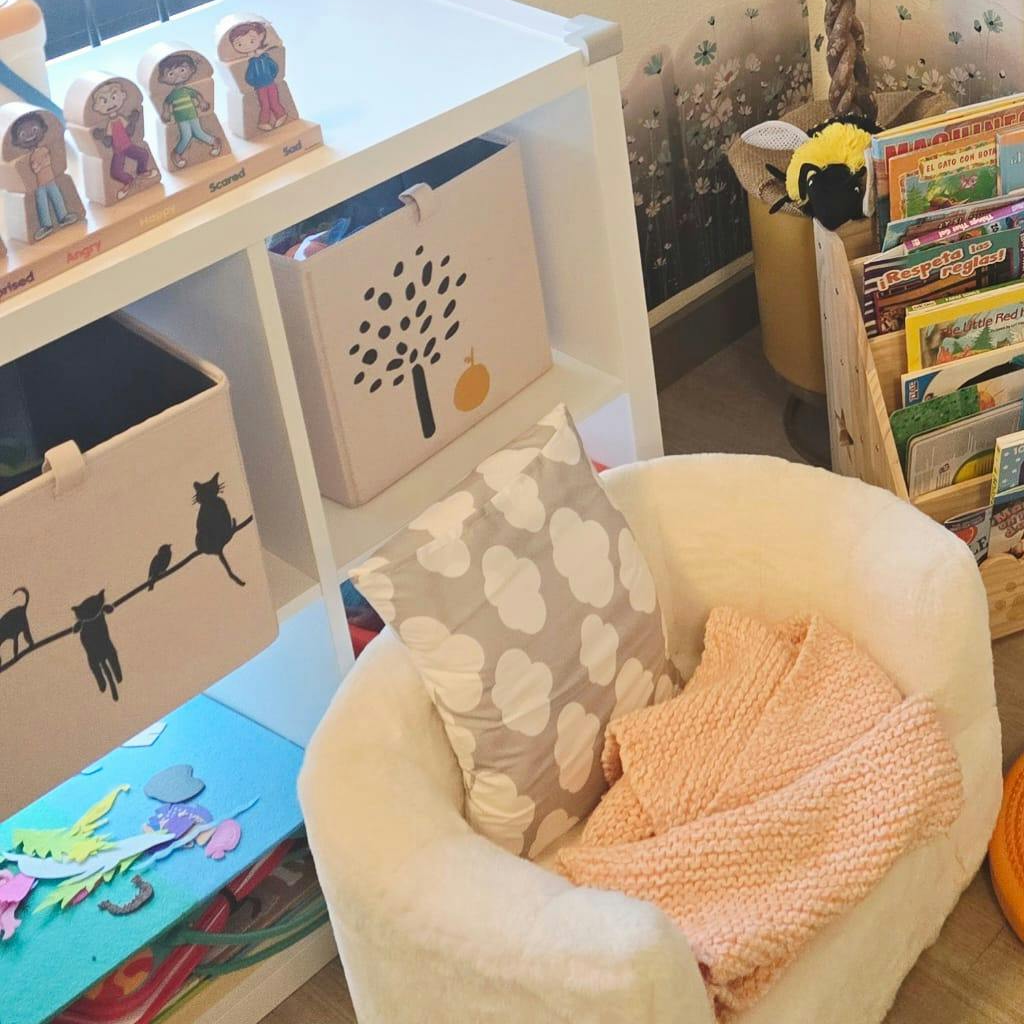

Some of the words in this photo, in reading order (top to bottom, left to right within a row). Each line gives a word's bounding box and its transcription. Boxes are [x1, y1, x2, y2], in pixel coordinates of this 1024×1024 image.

[926, 163, 935, 173] EL
[937, 157, 957, 170] GATO
[959, 153, 975, 164] CON
[67, 240, 101, 264] Angry
[208, 167, 247, 193] Scared
[283, 140, 303, 157] Sad
[969, 213, 994, 227] Things
[877, 247, 964, 291] ¡Respeta
[968, 240, 993, 255] las
[939, 247, 1007, 280] reglas!
[940, 324, 961, 337] The
[963, 315, 994, 334] Little
[994, 306, 1019, 325] Red
